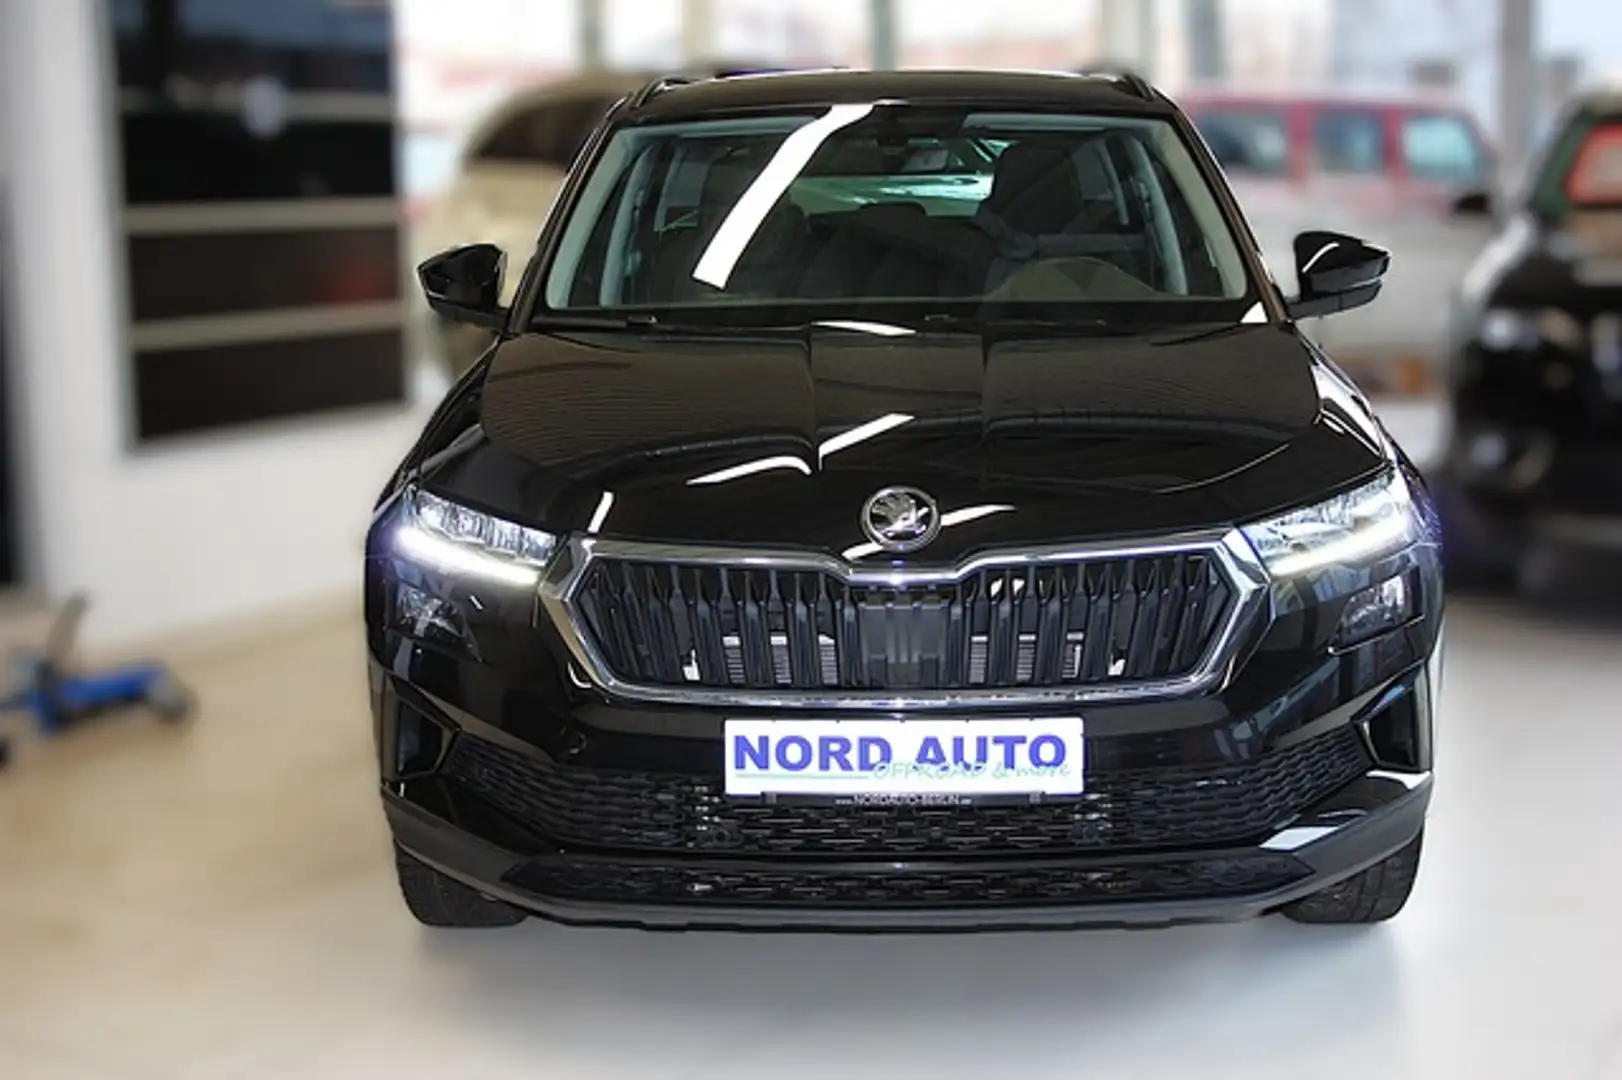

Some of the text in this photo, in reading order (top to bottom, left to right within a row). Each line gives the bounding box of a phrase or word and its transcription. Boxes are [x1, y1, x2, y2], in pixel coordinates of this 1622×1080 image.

[733, 734, 1066, 772] NORD AUTO
[991, 761, 1010, 779] &
